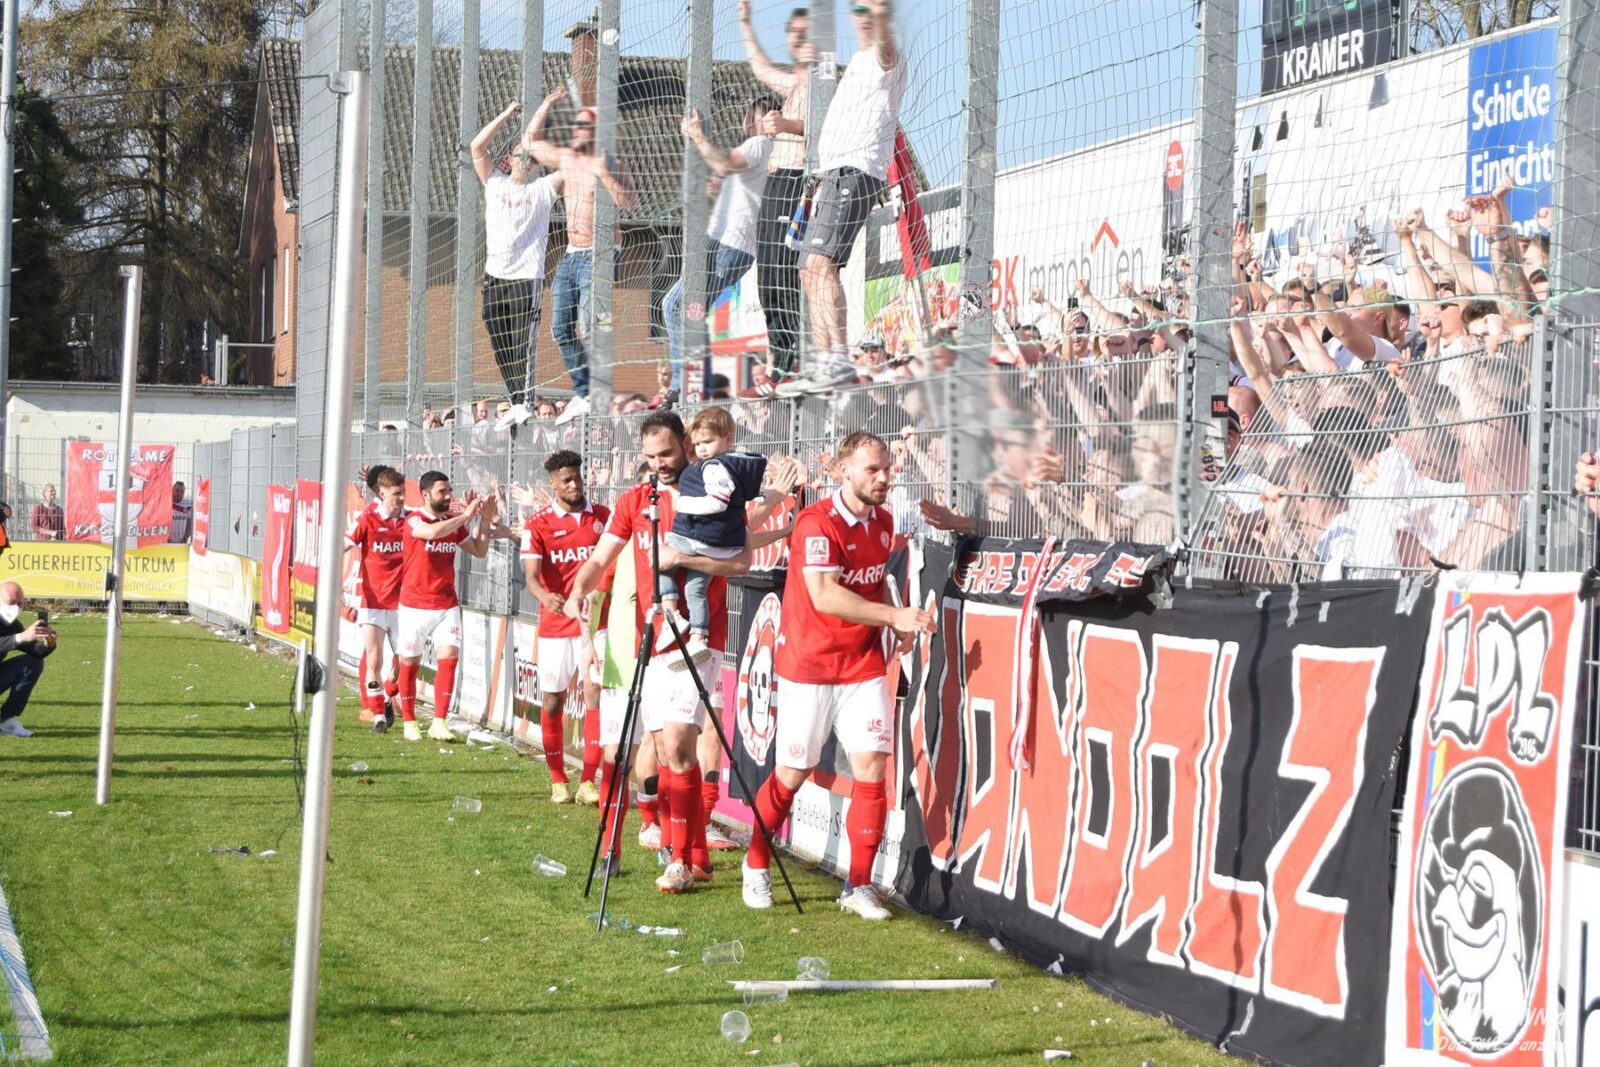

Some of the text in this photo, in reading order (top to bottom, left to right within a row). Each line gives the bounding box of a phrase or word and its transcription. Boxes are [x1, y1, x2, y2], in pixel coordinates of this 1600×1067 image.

[1282, 28, 1365, 86] KRAMER
[1471, 74, 1551, 131] Schicke
[1471, 140, 1555, 195] Einricht
[1022, 240, 1144, 306] Immobilien
[8, 553, 175, 574] SICHERHEITSZNTRUM
[372, 541, 404, 553] HAR
